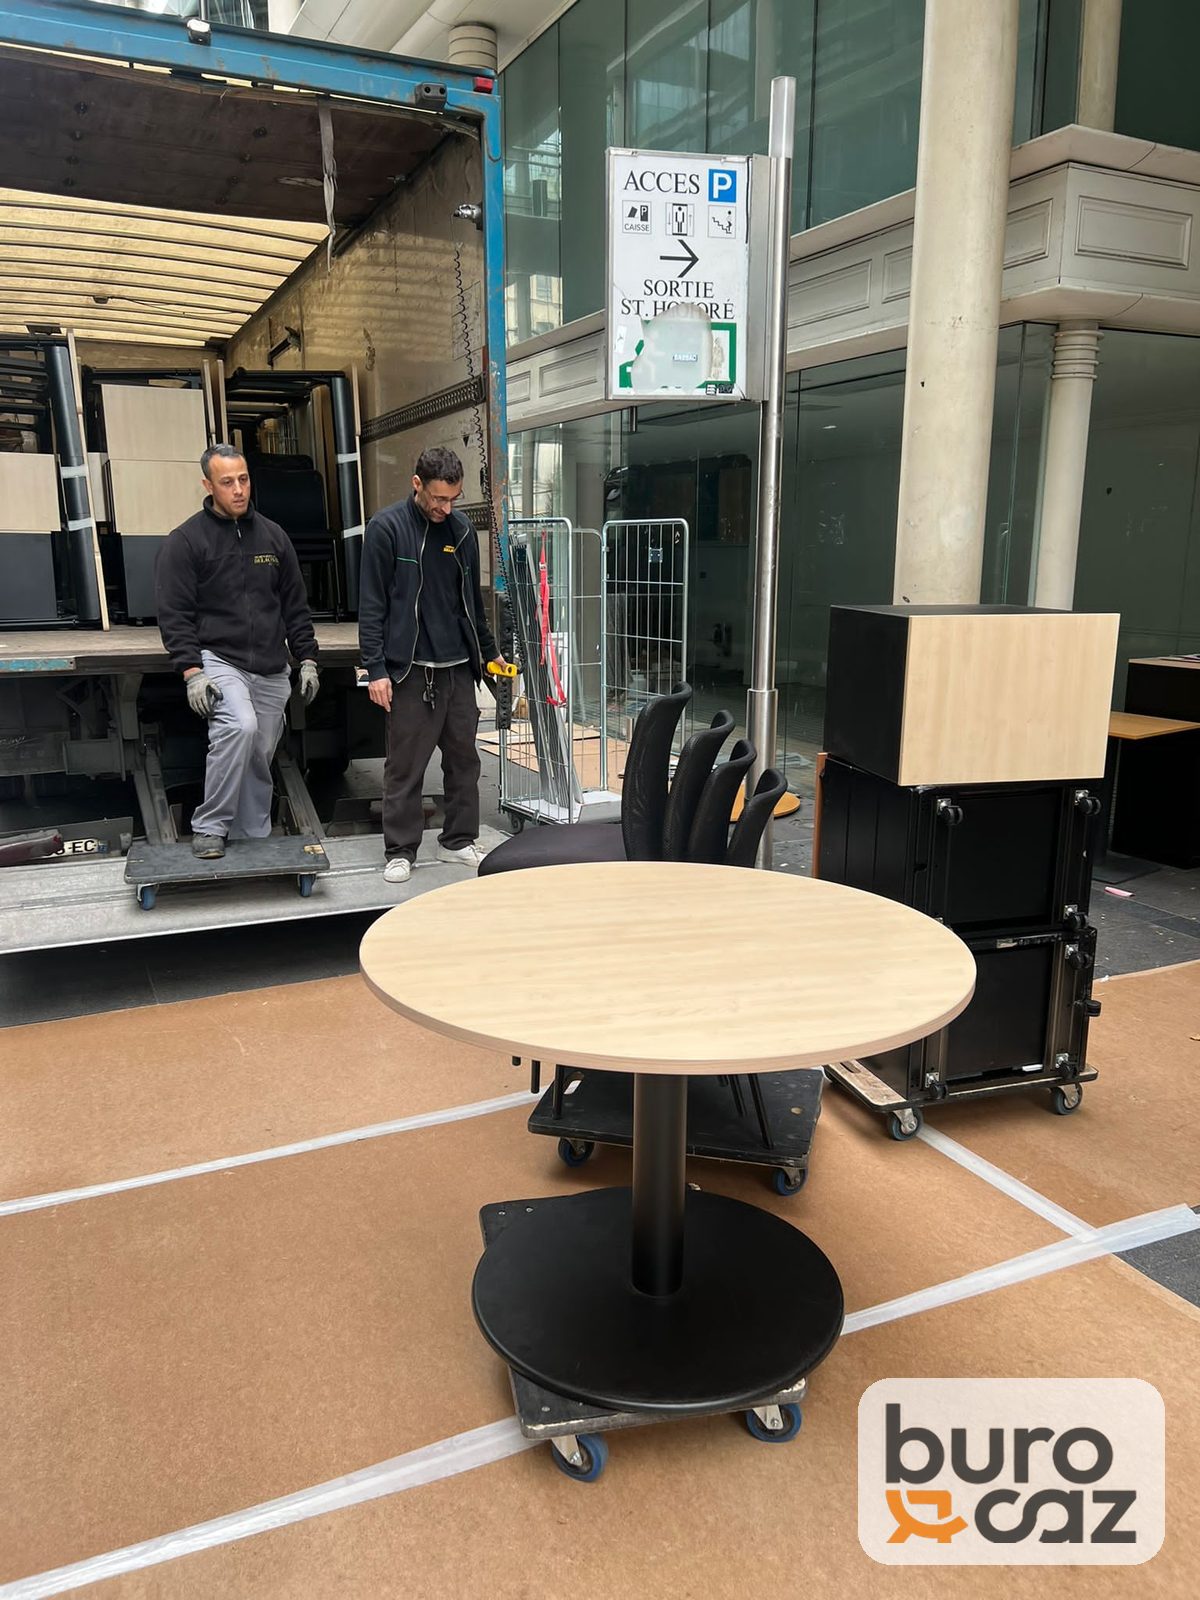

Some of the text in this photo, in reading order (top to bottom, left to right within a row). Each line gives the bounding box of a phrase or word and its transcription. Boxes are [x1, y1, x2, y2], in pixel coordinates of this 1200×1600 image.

[623, 170, 733, 199] ACCES P
[624, 223, 650, 232] CAISSE
[643, 279, 714, 298] SORTIE
[621, 299, 649, 317] ST.
